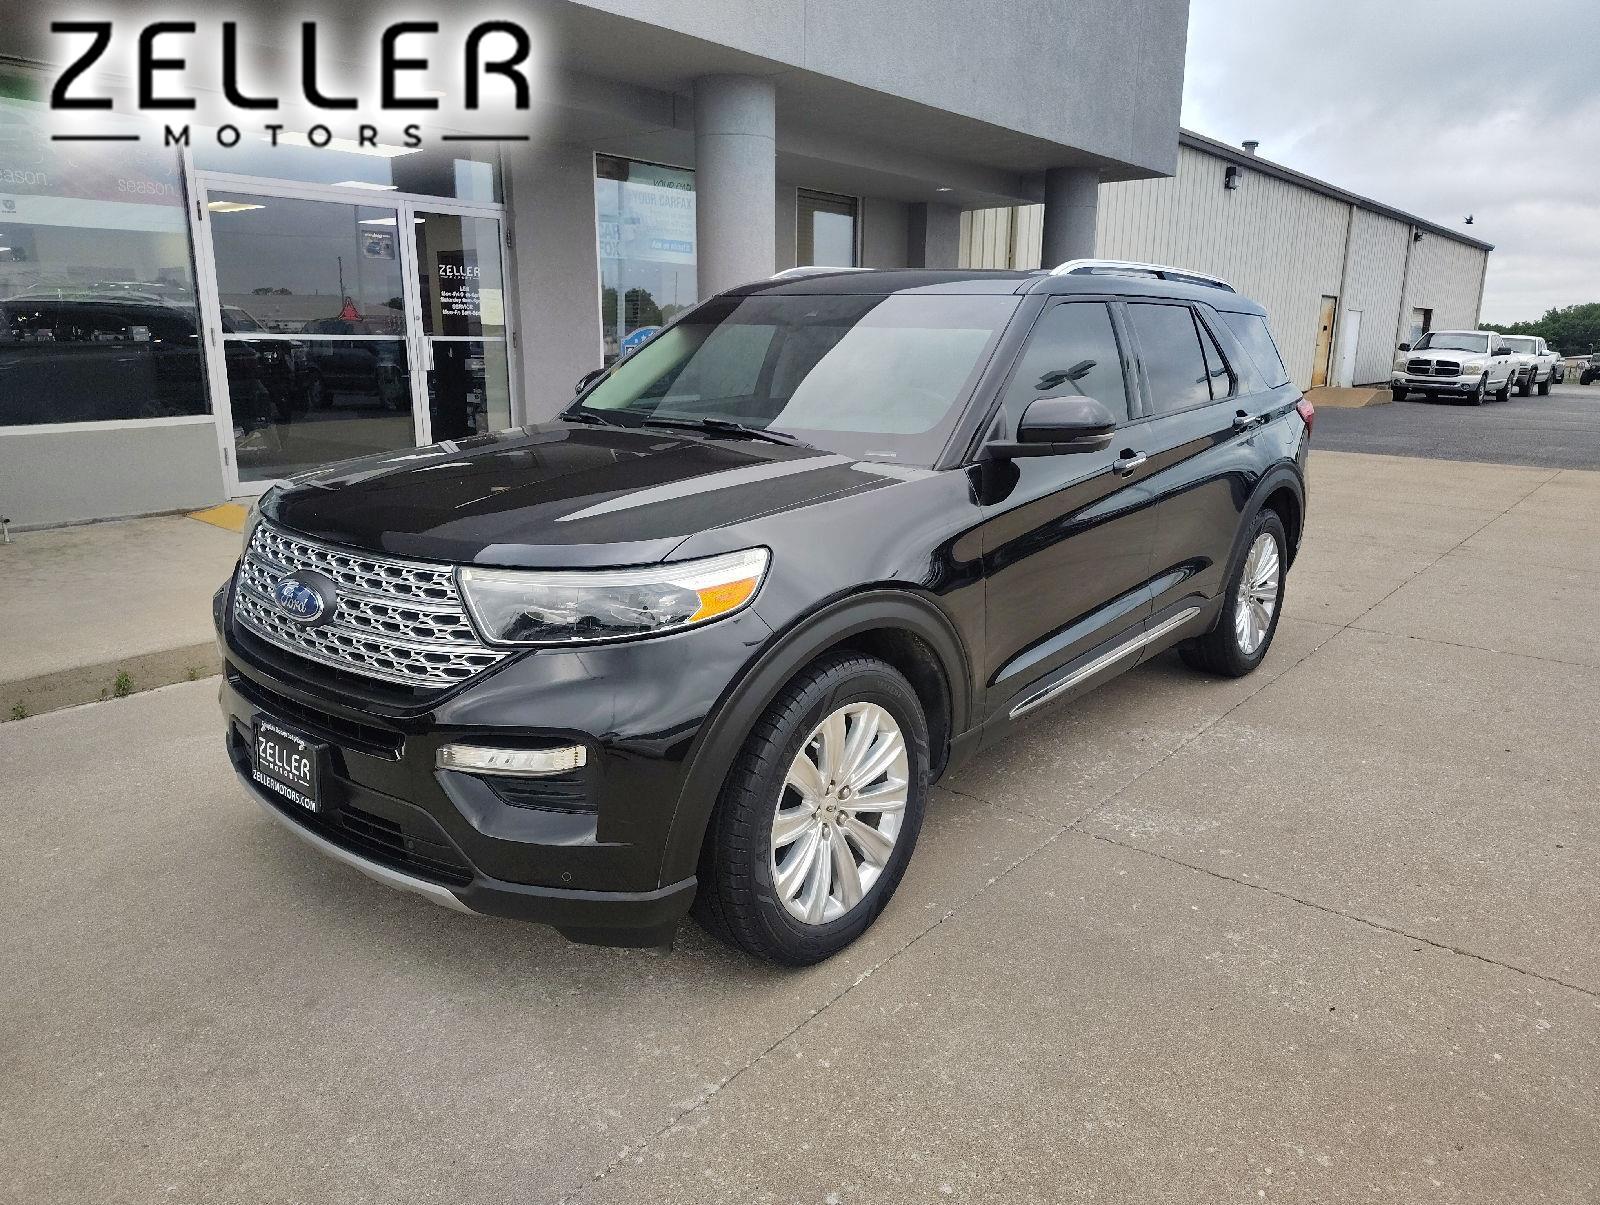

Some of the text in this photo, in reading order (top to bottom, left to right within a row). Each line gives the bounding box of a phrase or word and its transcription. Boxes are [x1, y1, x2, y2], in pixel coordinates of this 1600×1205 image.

[438, 264, 480, 277] ZELLER
[281, 585, 308, 613] Ford
[258, 736, 310, 781] ZELLER
[252, 769, 317, 813] ZELLERMOTORS.COM
